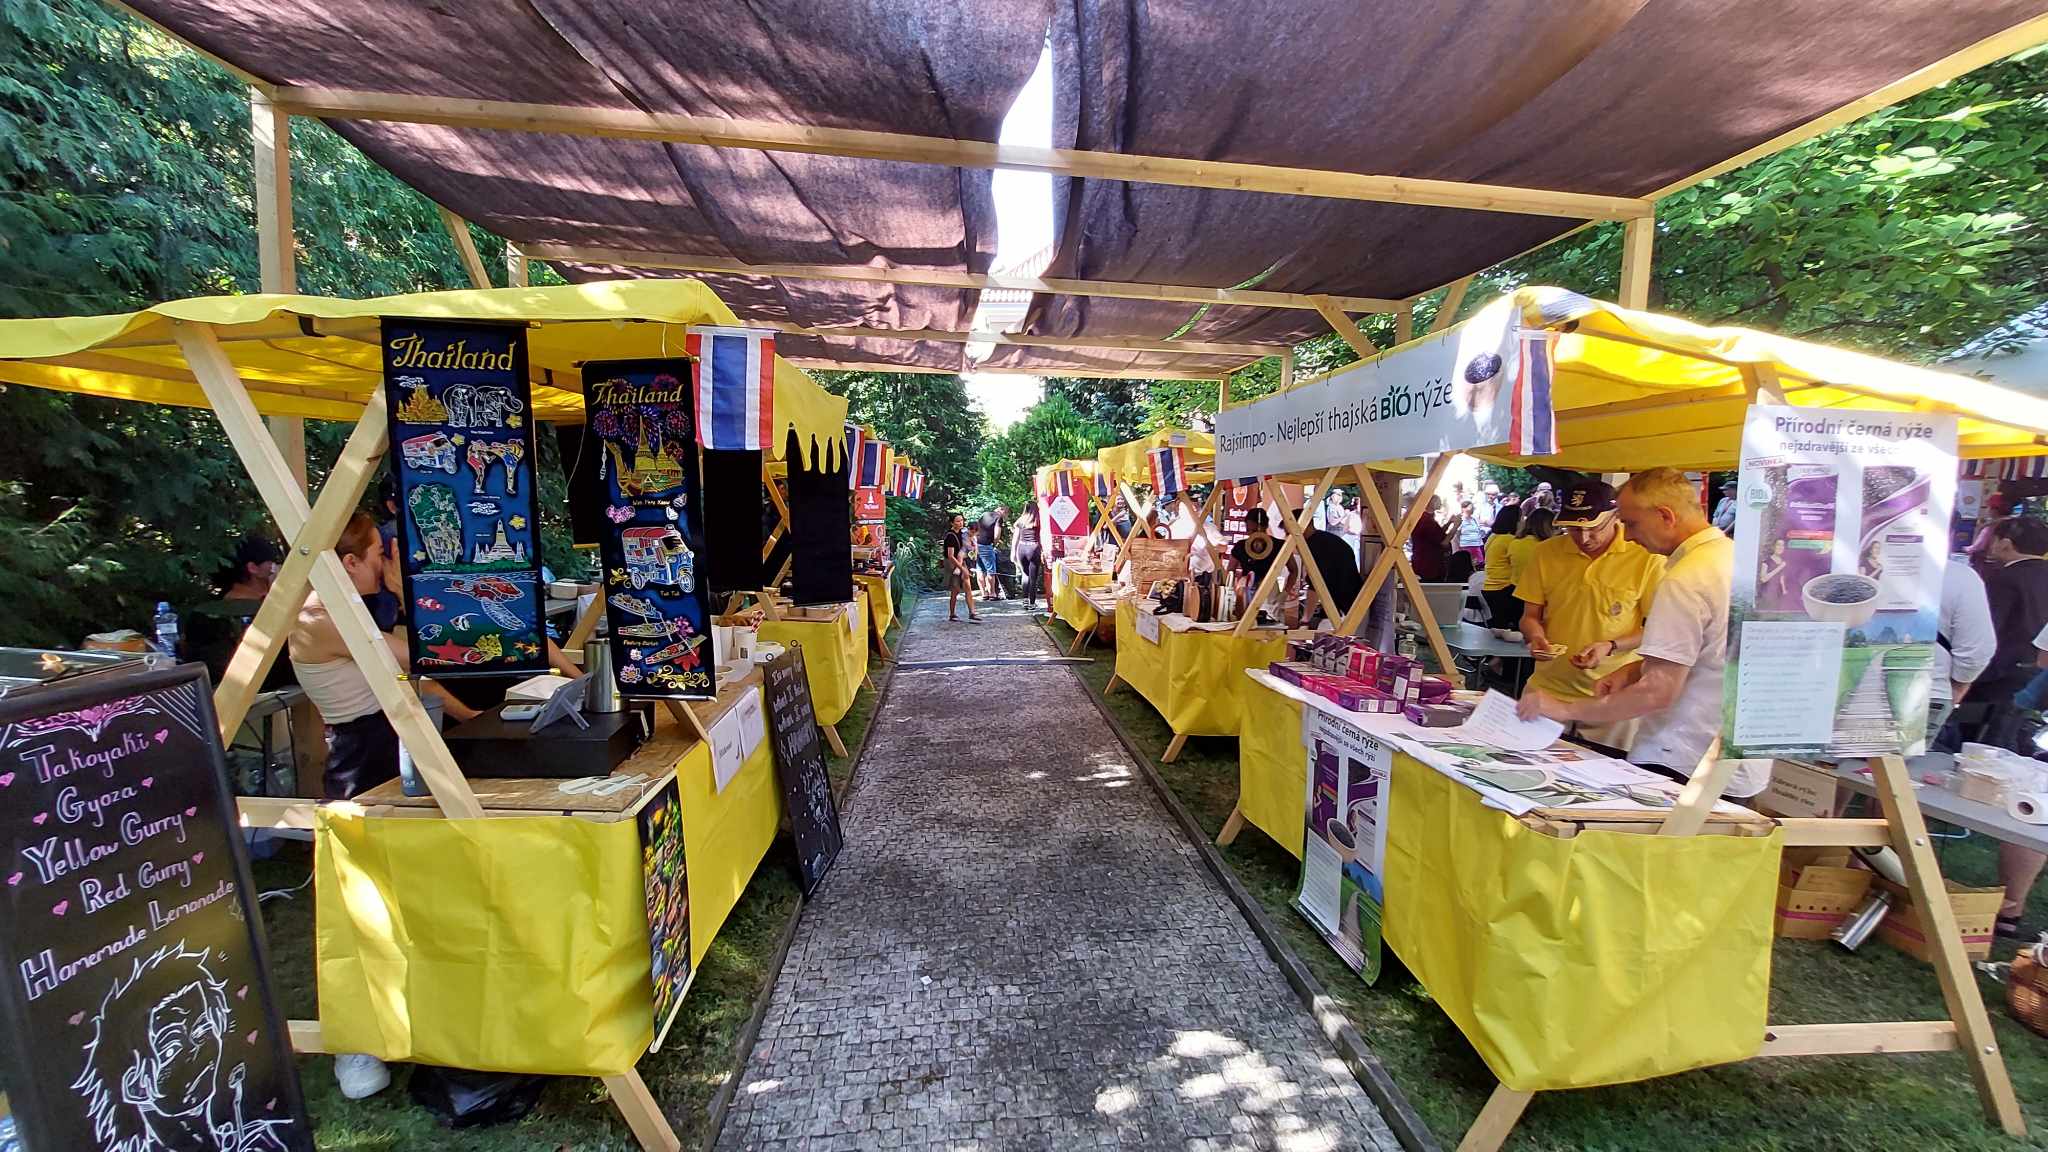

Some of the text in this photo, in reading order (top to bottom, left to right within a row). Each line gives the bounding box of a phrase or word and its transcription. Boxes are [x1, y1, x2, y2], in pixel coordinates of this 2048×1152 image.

[389, 333, 516, 371] Thailand
[592, 378, 684, 406] Thailand
[1220, 430, 1266, 455] Rajsimpo
[1277, 411, 1325, 445] Nejlepší
[1328, 396, 1377, 433] thajská
[1776, 416, 1934, 440] Přírodní černá rýže
[1780, 439, 1848, 455] nejzdravější
[20, 731, 149, 784] Takoyaki
[1342, 725, 1360, 742] černá
[1361, 735, 1379, 751] rýže
[57, 785, 137, 827] Gyoza
[22, 811, 186, 884] Yellow Curry
[80, 858, 192, 914] Red Curry
[19, 880, 235, 1000] Homemade Lemonade
